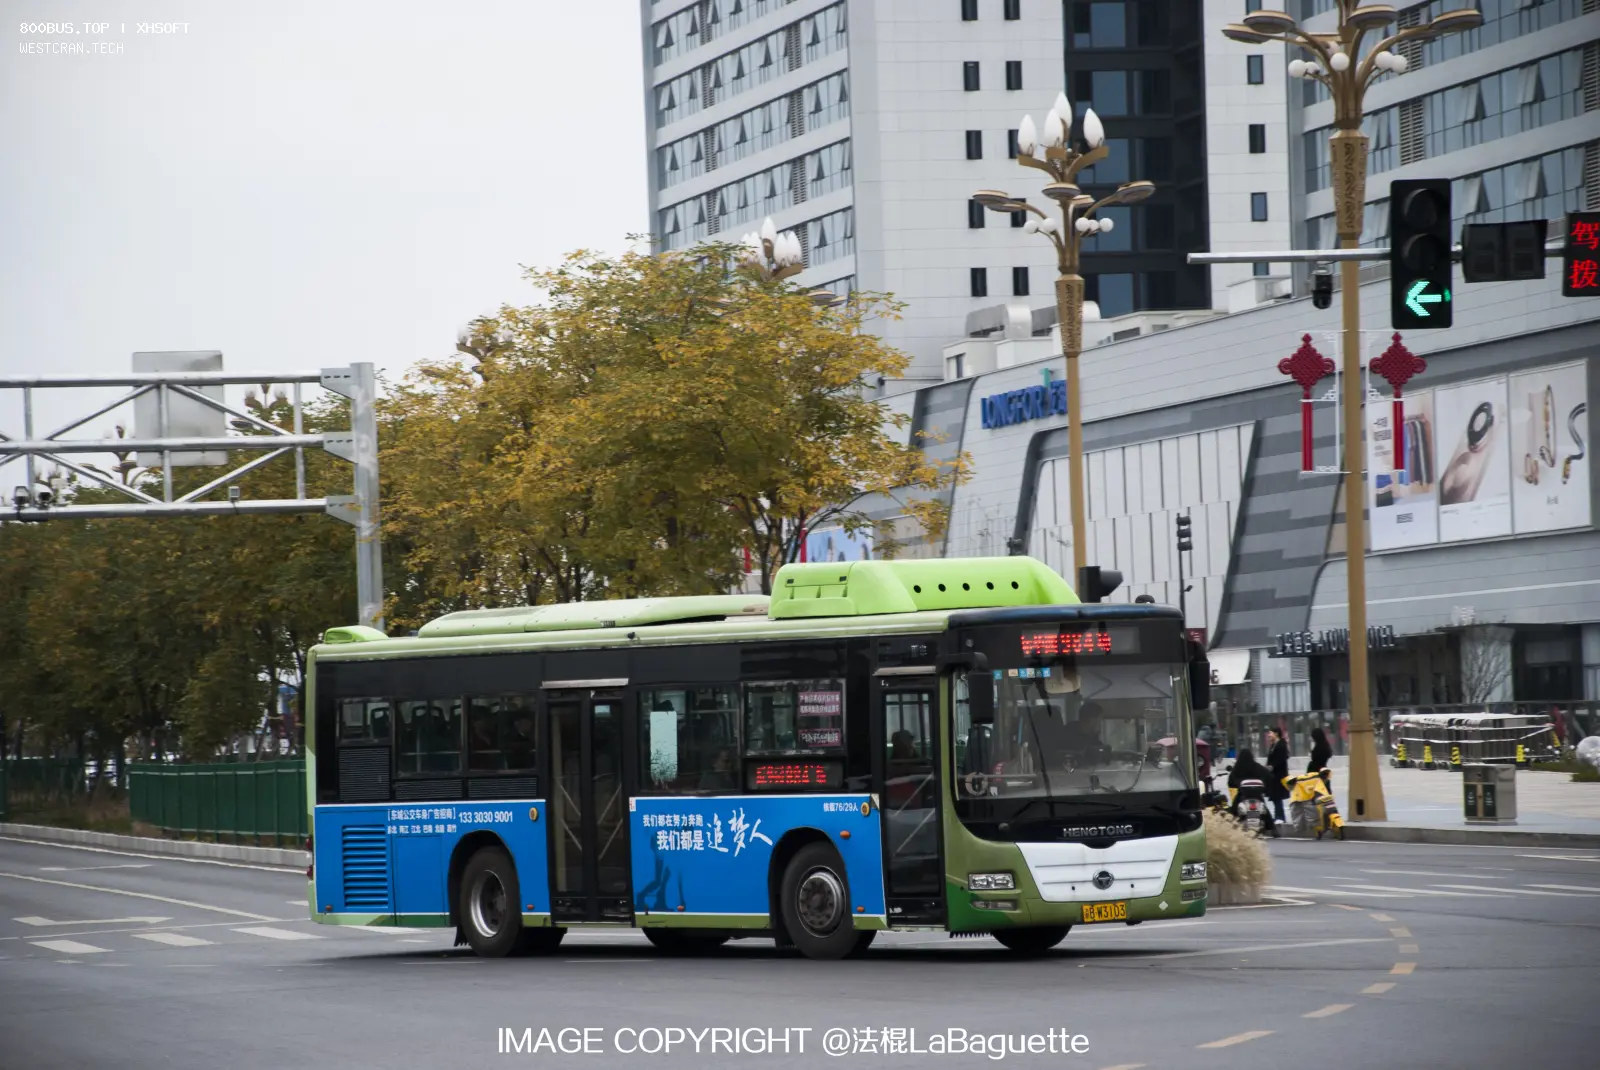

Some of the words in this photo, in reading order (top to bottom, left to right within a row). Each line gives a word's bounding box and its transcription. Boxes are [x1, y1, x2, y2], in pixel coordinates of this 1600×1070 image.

[981, 385, 1047, 429] LONGFOR
[458, 811, 472, 823] 133
[474, 811, 493, 823] 3030
[494, 811, 513, 822] 9001
[643, 813, 704, 828] 我们都在努力奔跑
[1063, 824, 1133, 837] HENGTONG
